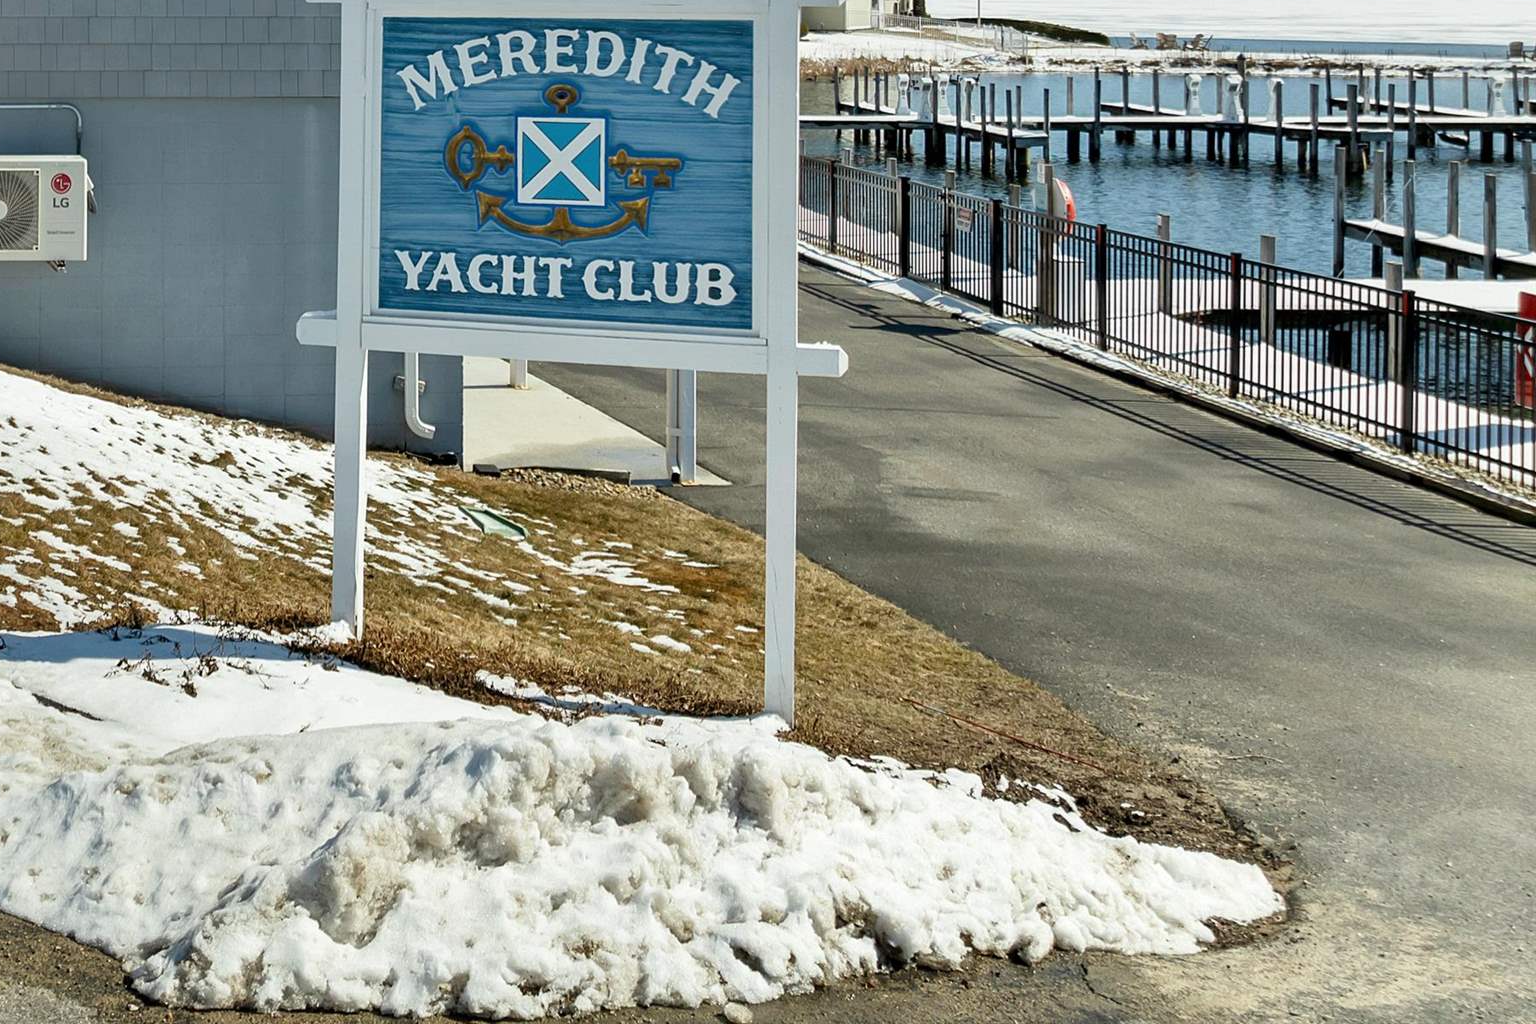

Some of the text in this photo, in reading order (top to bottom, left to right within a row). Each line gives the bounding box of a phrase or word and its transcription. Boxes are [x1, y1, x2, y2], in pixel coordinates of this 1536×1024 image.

[396, 29, 741, 120] MEREDITH
[52, 197, 70, 208] LG
[394, 250, 738, 307] YACHT CLUB
